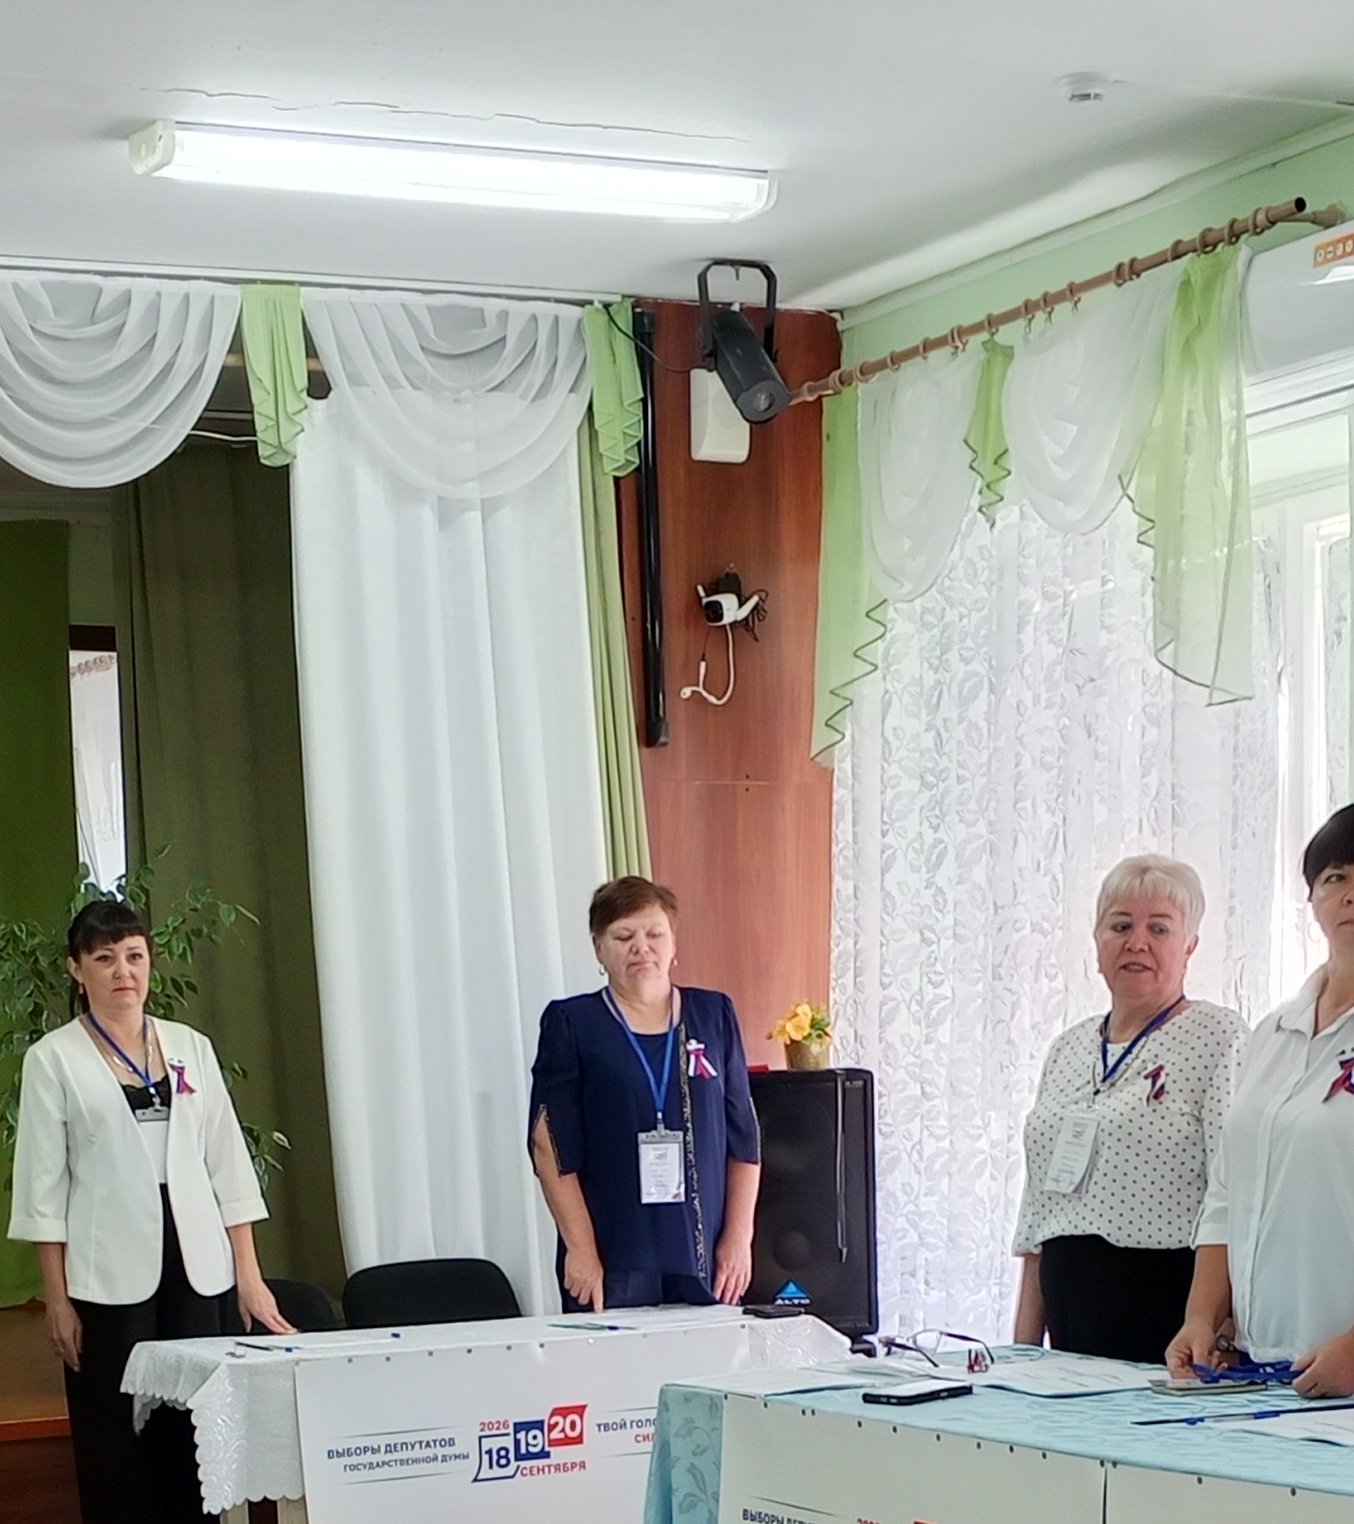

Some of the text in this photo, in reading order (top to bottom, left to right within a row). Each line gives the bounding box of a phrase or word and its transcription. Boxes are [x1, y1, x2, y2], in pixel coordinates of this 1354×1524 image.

[479, 1420, 510, 1432] 2026
[596, 1418, 627, 1433] ТВОЙ
[327, 1437, 456, 1460] ВЫБОРЫ ДЕПУТАТОВ
[484, 1413, 582, 1470] 18 19 20
[343, 1452, 470, 1472] ГОСУДАРСТВЕННОЙ ДУМЫ
[520, 1460, 587, 1477] СЕНТЯБРЯ
